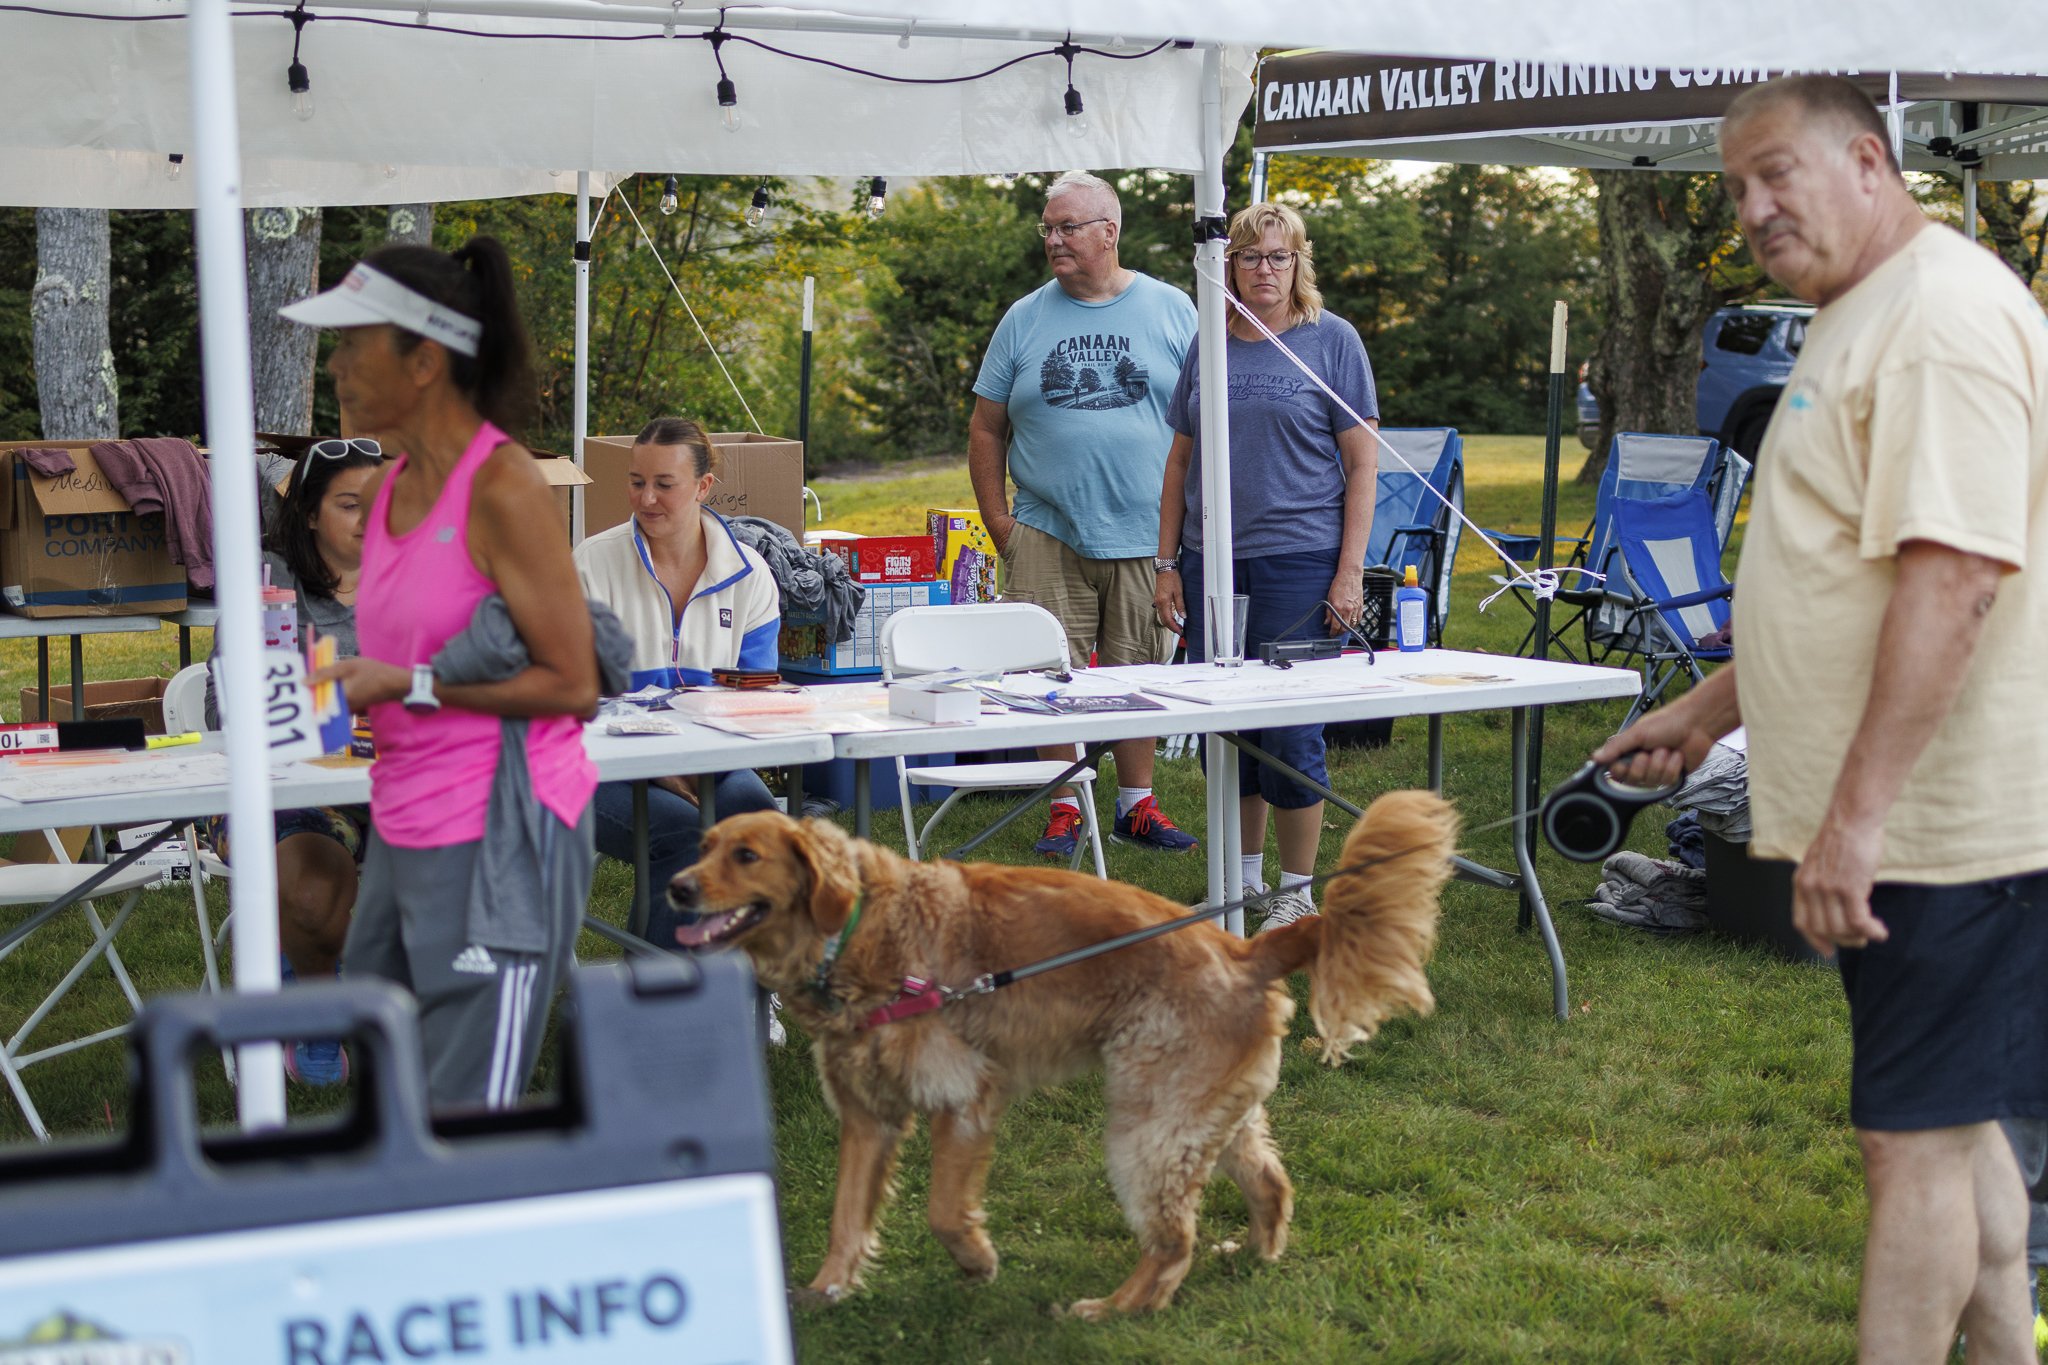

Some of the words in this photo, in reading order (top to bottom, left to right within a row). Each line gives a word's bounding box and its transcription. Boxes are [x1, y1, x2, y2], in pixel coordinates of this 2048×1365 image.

[1263, 75, 1371, 122] CANAAN
[1379, 62, 1487, 111] VALLEY
[1056, 334, 1130, 357] CANAAN
[1069, 349, 1121, 363] VALLEY
[1251, 373, 1304, 393] VALLEY
[51, 472, 114, 492] Mediu
[705, 493, 748, 511] arge
[44, 511, 128, 538] PORT
[45, 534, 164, 557] COMPANY
[939, 582, 949, 591] 42
[721, 612, 731, 621] 94
[283, 1297, 485, 1365] RACE
[509, 1272, 690, 1348] INFO
